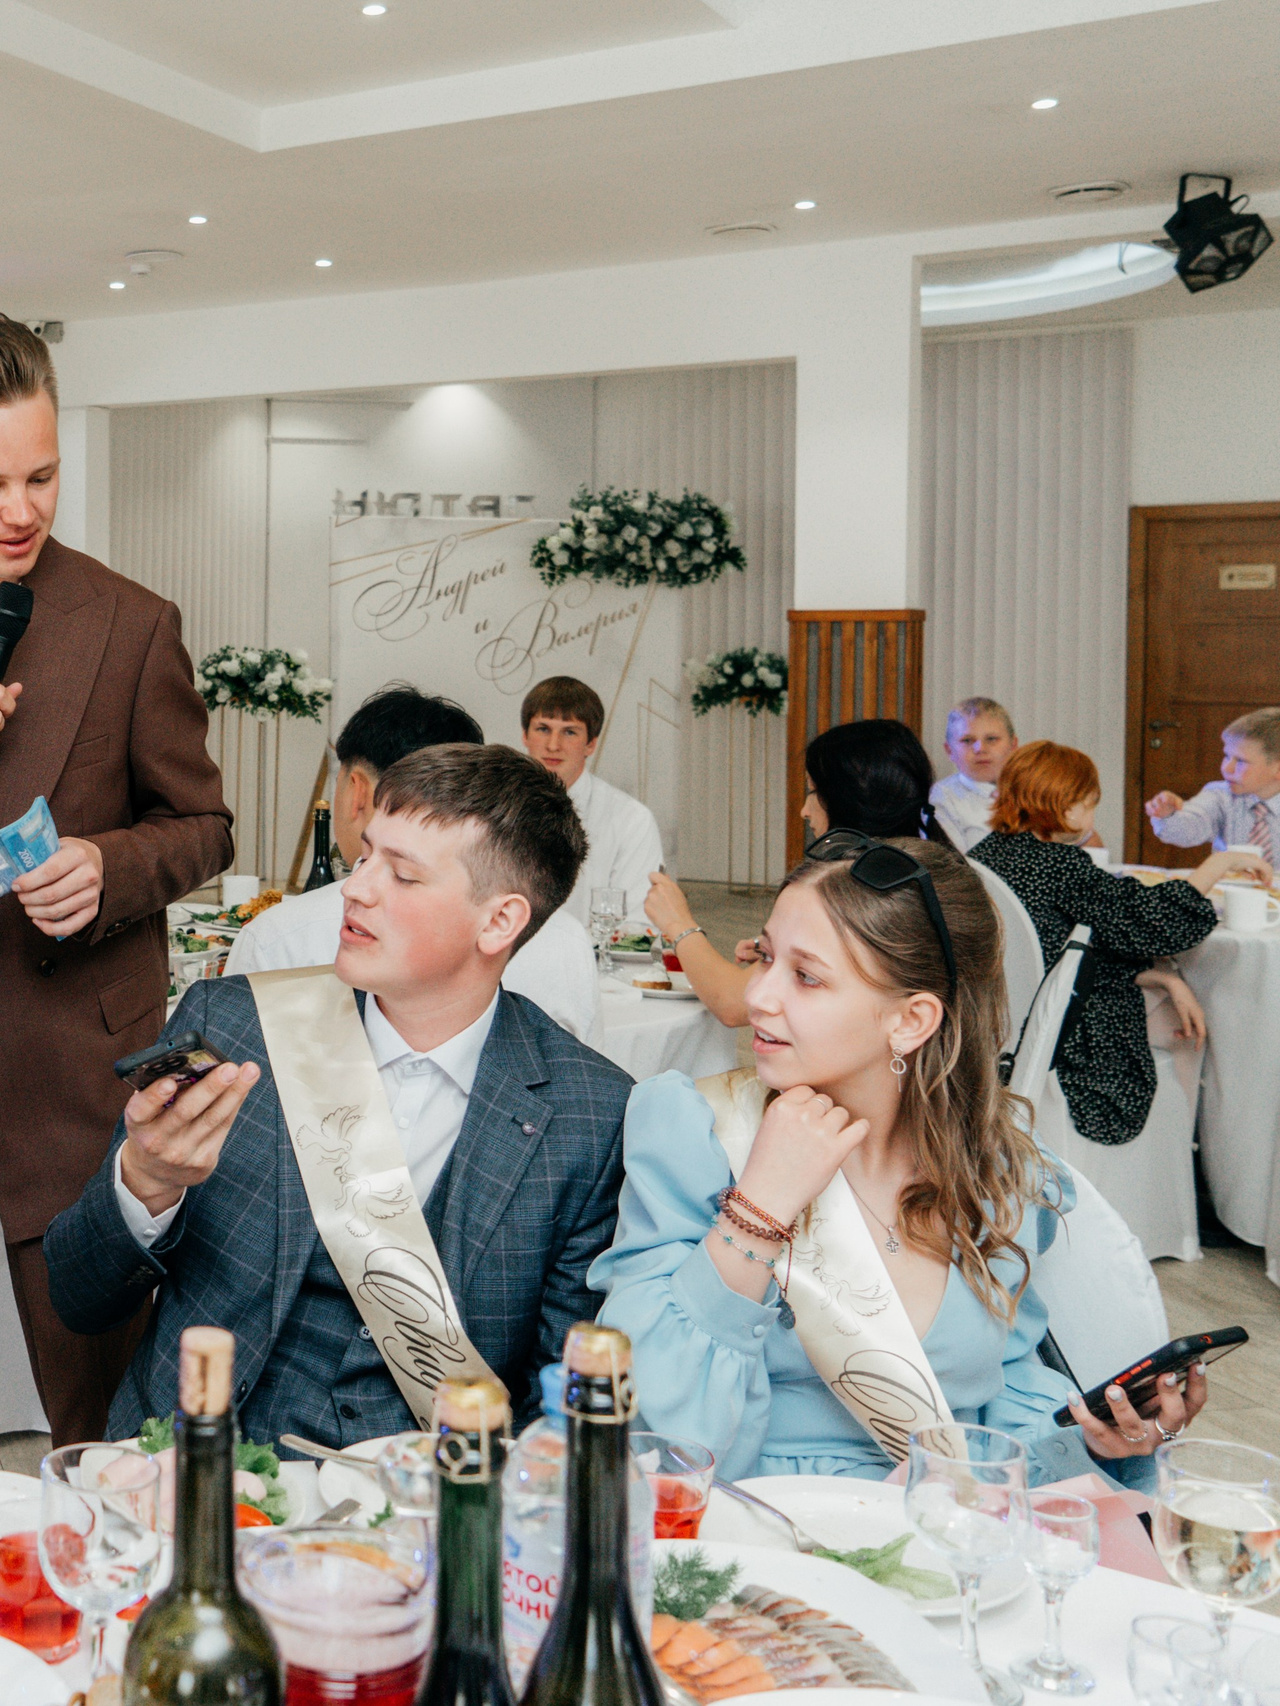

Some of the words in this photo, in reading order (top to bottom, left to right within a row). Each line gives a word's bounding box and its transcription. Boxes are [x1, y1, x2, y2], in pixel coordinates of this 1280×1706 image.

[352, 534, 506, 642] Андрей
[474, 618, 489, 634] и
[475, 578, 639, 695] Валерия
[18, 849, 34, 868] 2000
